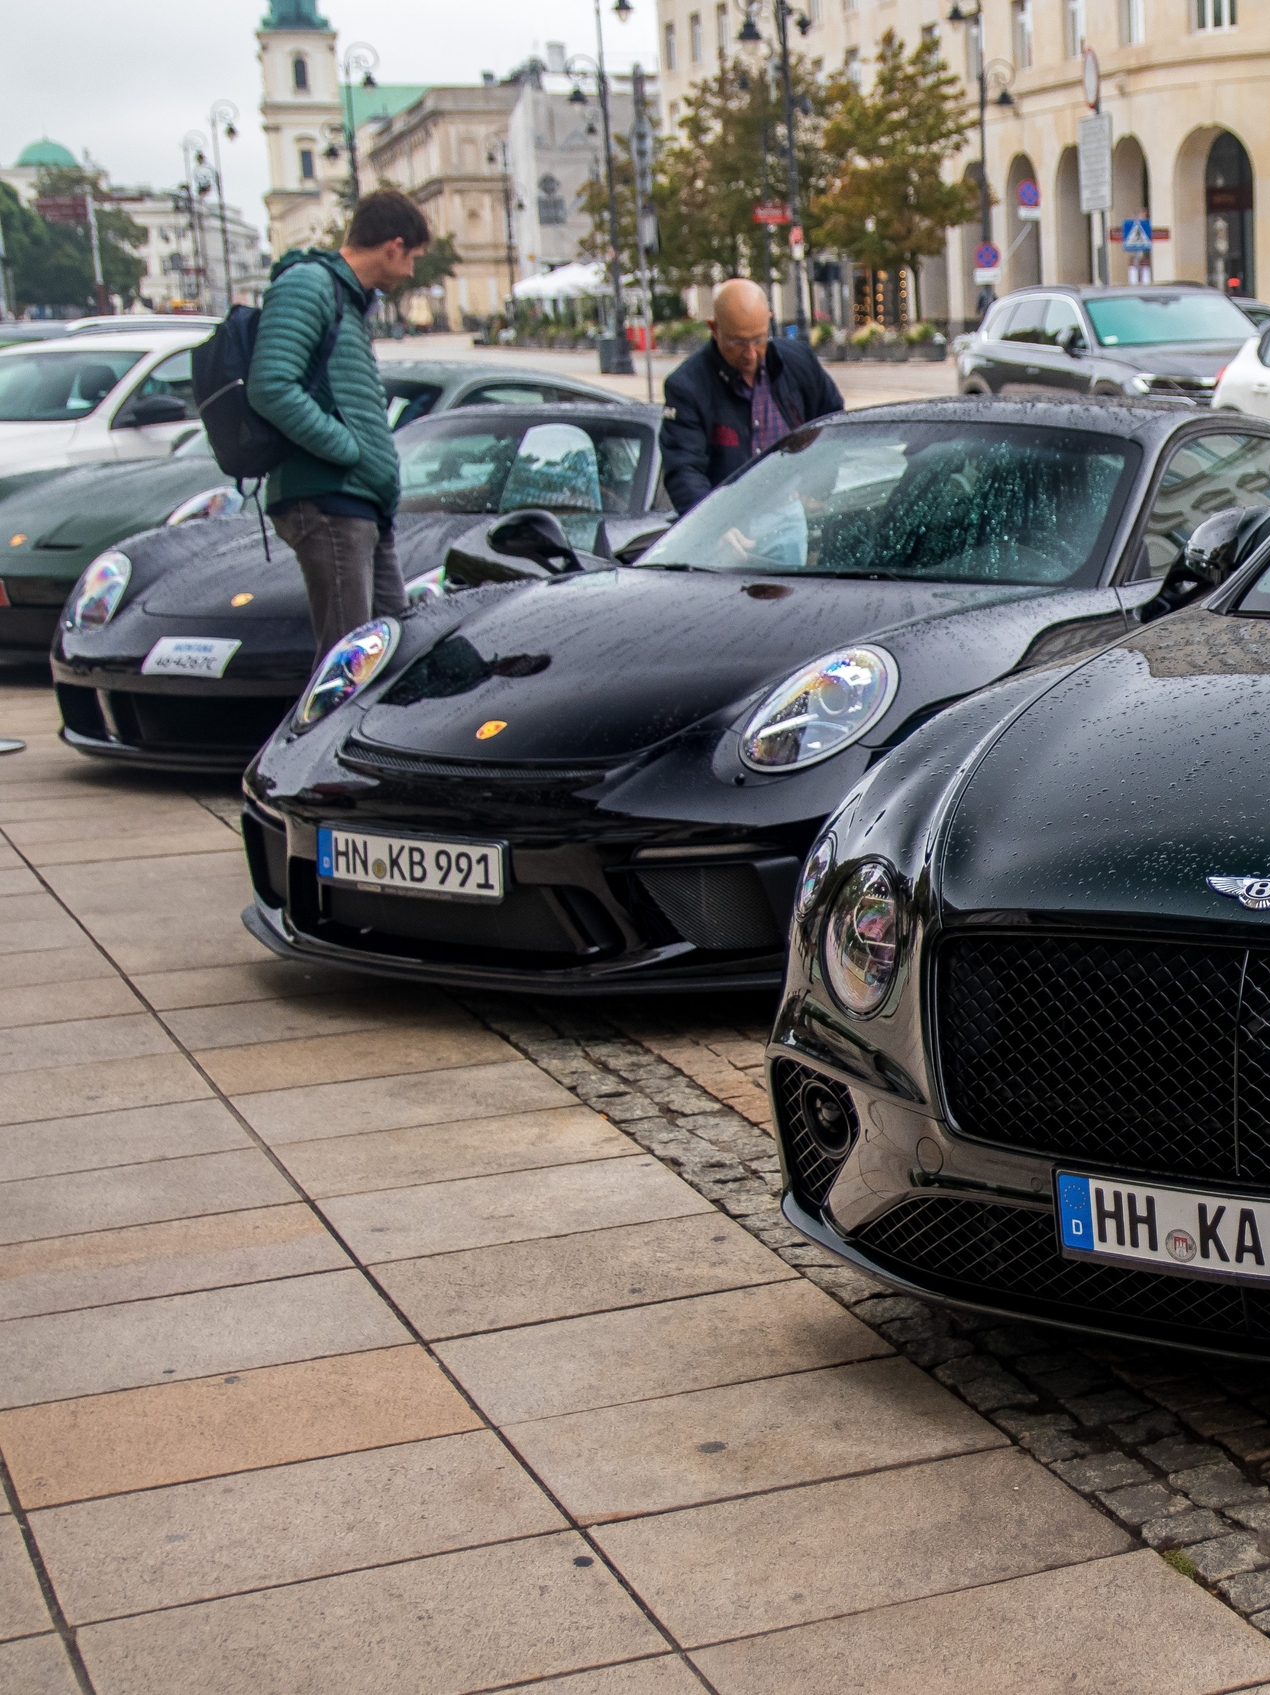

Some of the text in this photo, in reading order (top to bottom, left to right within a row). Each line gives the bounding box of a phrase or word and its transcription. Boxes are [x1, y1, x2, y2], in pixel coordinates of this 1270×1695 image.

[334, 836, 495, 890] HN KB 991
[1072, 1218, 1083, 1235] D
[1095, 1187, 1159, 1252] HH
[1197, 1202, 1265, 1266] KA
